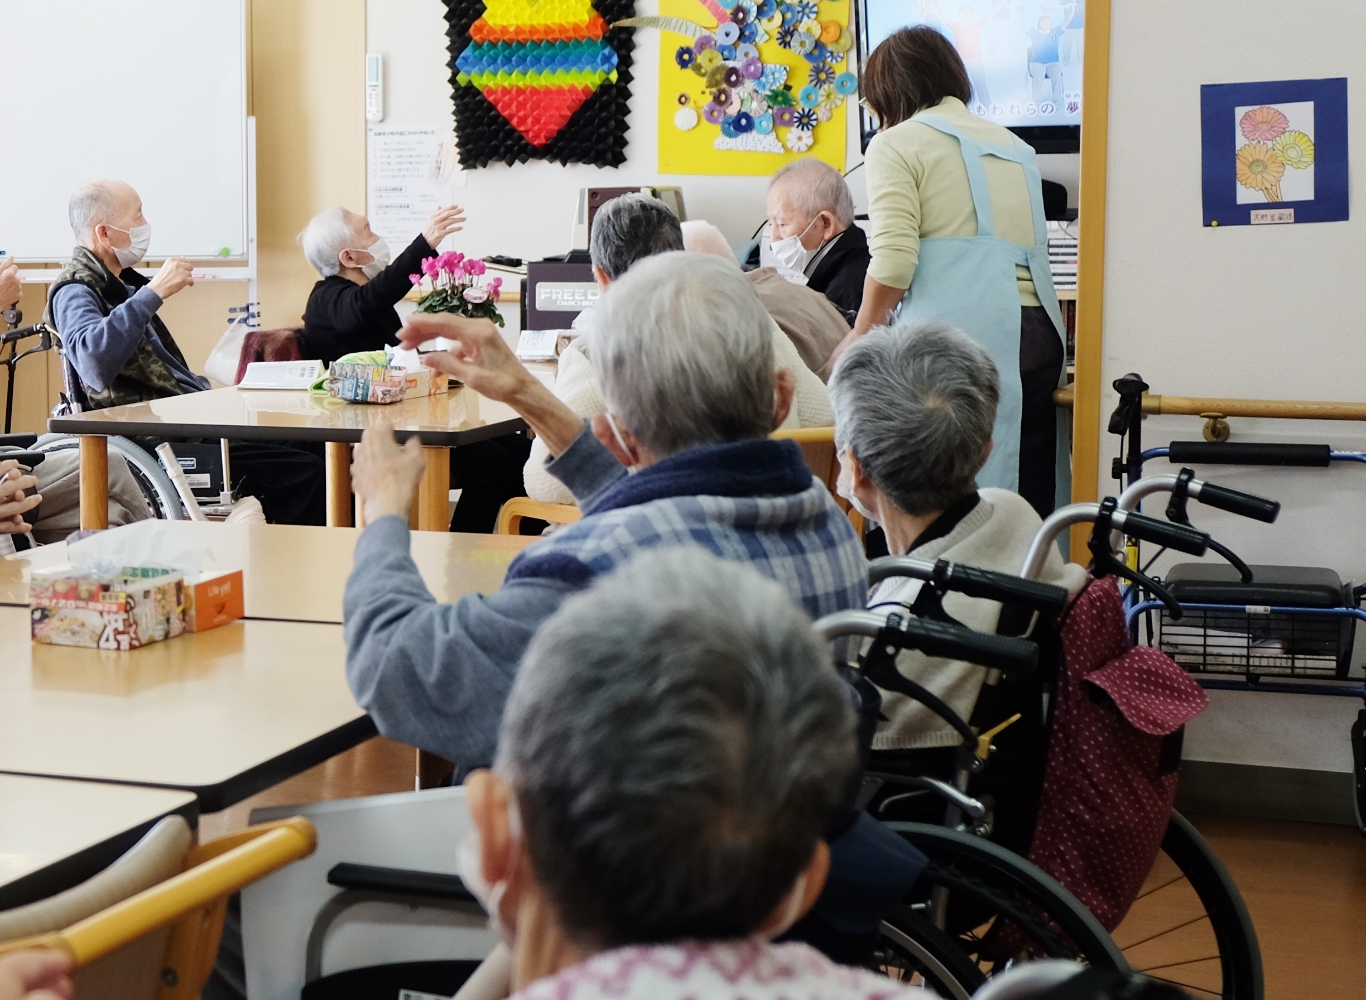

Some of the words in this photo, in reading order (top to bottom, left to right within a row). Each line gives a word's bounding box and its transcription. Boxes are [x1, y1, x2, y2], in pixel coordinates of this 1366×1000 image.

[968, 102, 1055, 117] もわれらの
[540, 289, 600, 300] FREED
